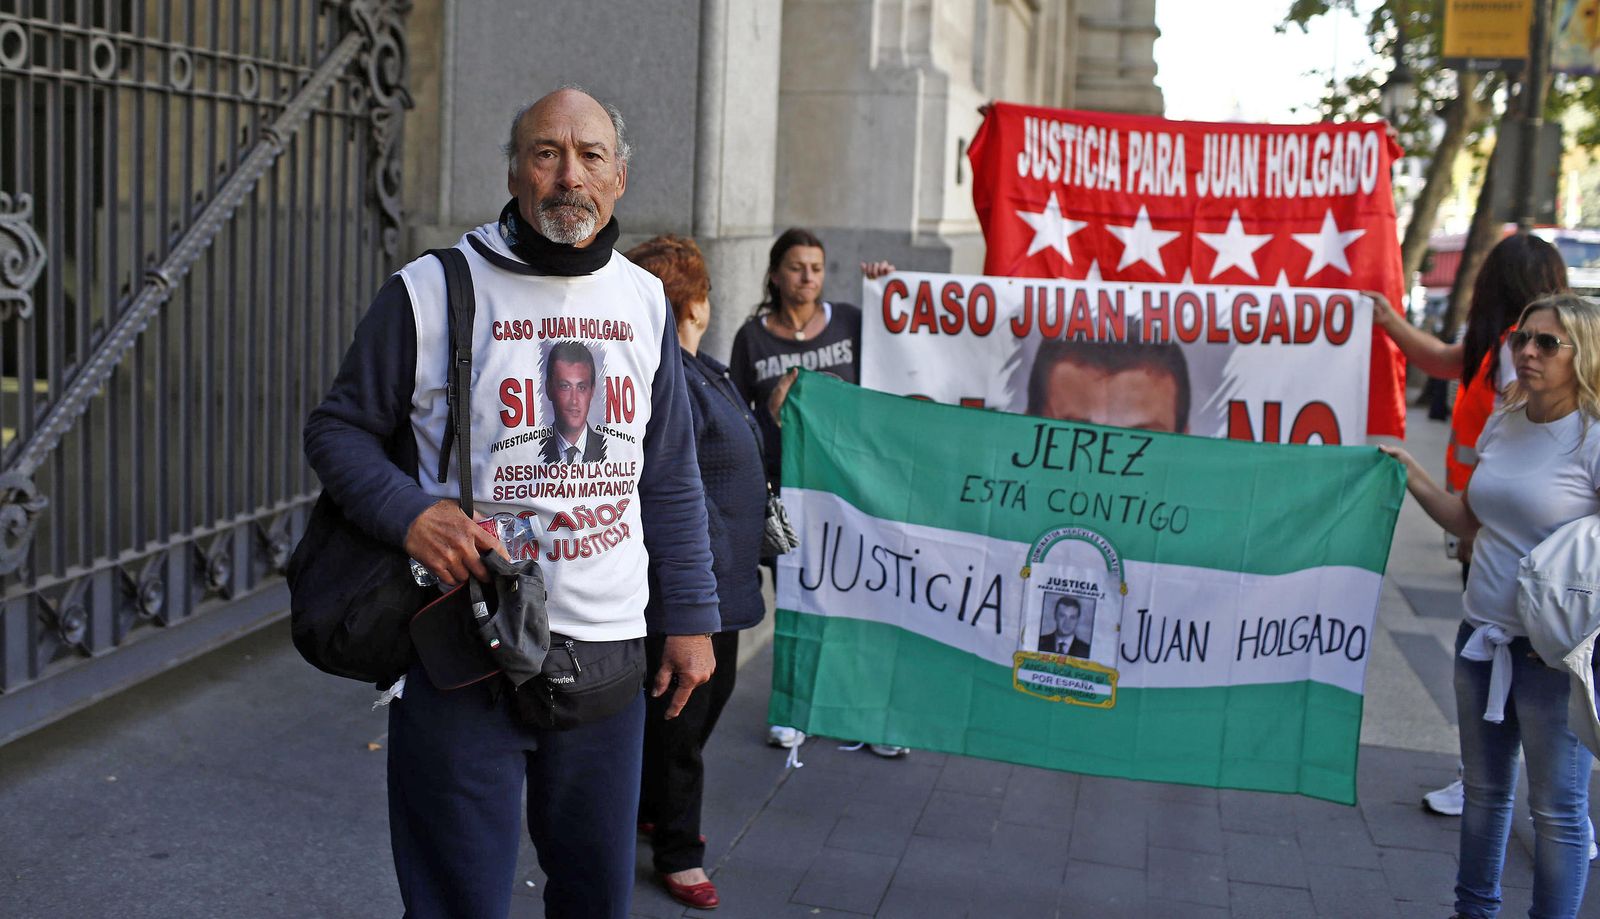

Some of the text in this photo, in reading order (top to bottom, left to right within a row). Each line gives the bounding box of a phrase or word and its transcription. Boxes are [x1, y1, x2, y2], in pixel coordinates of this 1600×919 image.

[1017, 116, 1380, 199] JUSTICIA PARA JUAN HOLGADO
[492, 317, 634, 342] CASO JUAN HOLGADO
[882, 278, 1354, 346] CASO JUAN HOLGADO
[755, 339, 853, 381] RAMONES
[498, 375, 636, 428] SI NO
[490, 426, 554, 453] INVESTIGACIÓN
[595, 424, 635, 444] ARCHIVO
[1011, 422, 1153, 476] JEREZ
[493, 461, 636, 483] ASESINOS EN LA CALLE
[493, 480, 635, 501] SEGUIRÁN MATANDO
[960, 474, 1029, 512] ESTÁ
[546, 522, 632, 562] JUSTICIA
[1047, 577, 1099, 592] JUSTICIA
[1120, 608, 1367, 664] JUAN HOLGADO
[1032, 672, 1095, 691] POR ESPAÑA
